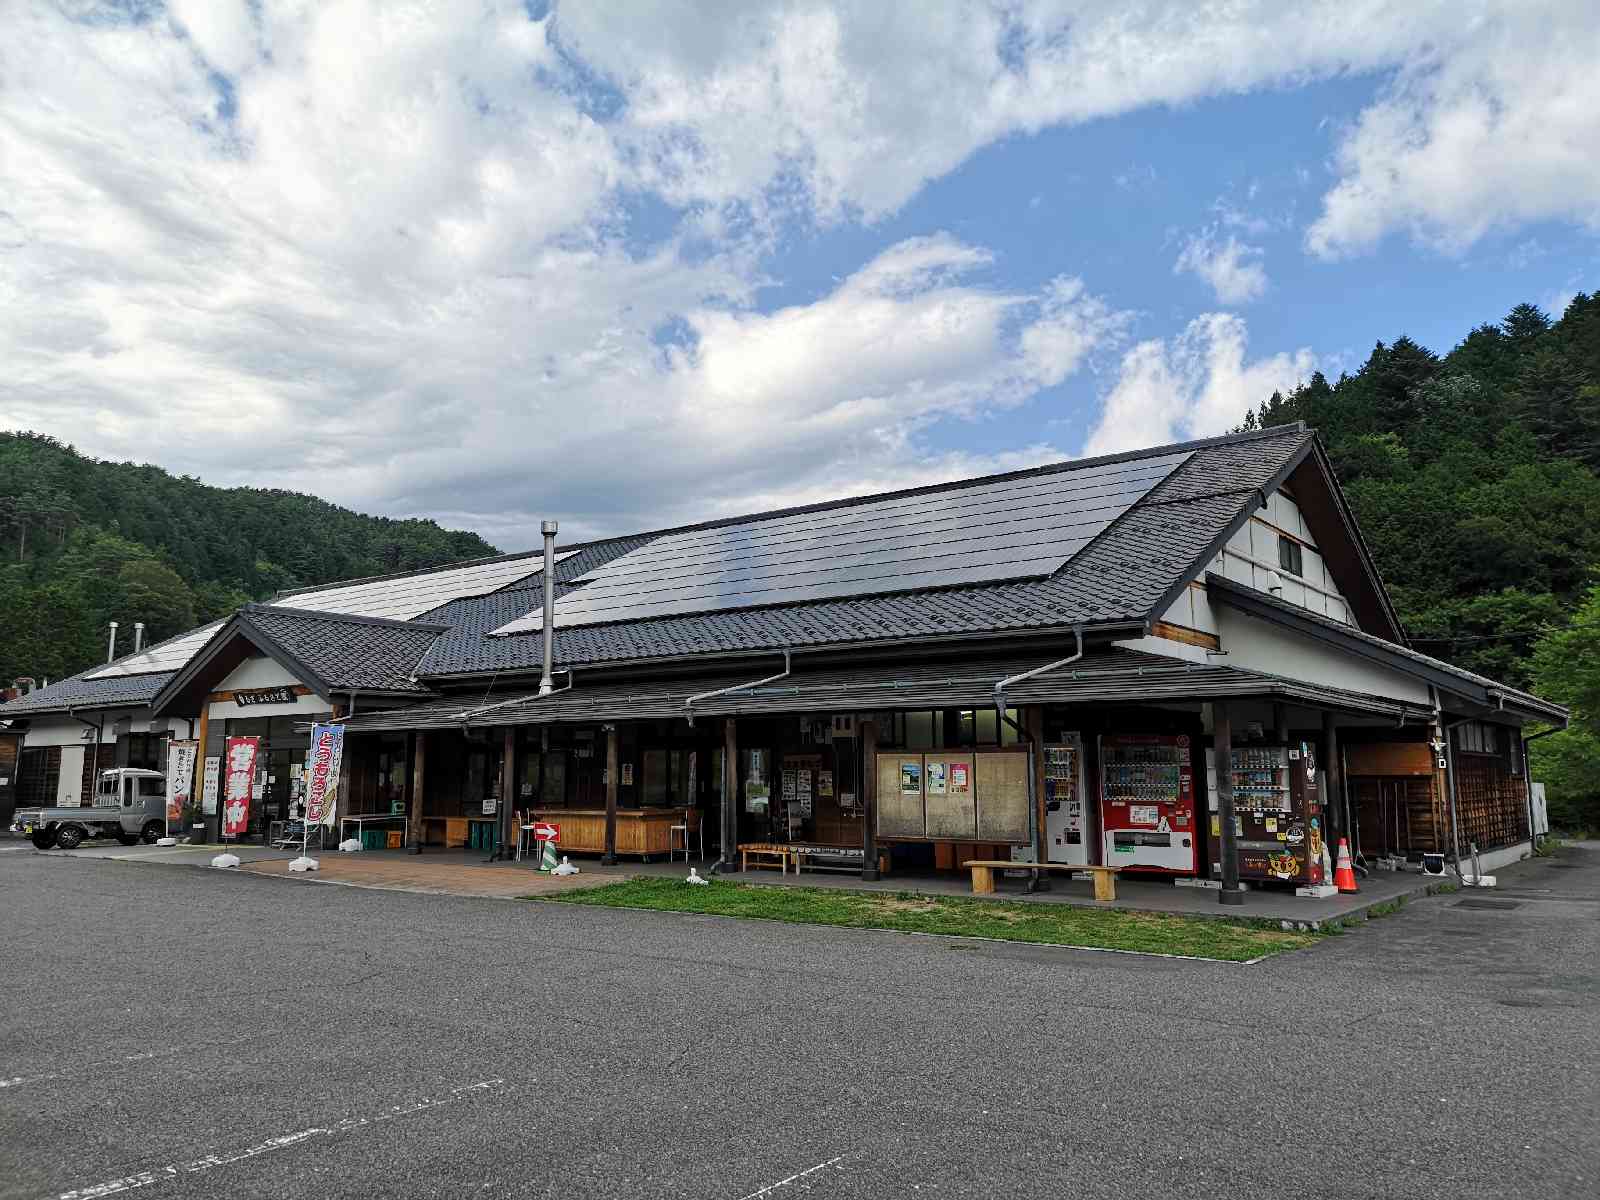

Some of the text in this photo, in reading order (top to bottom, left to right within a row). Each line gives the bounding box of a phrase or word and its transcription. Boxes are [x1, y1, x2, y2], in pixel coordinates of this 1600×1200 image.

[175, 748, 185, 794] 焼きたてパン
[227, 743, 255, 829] 営業中
